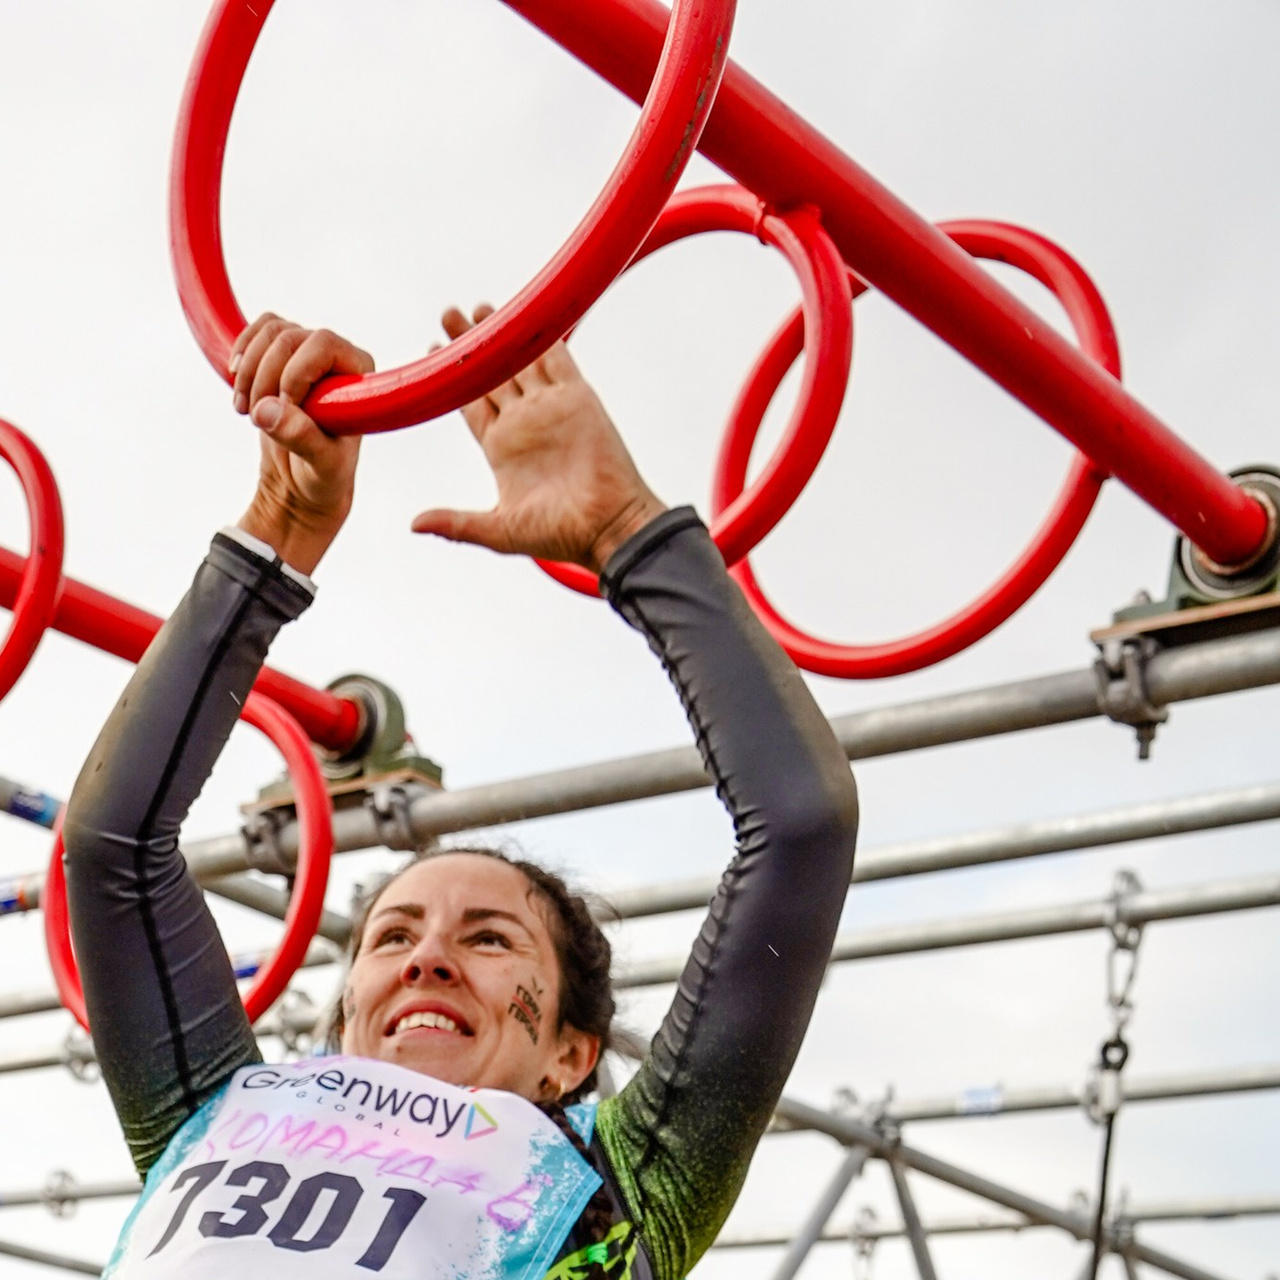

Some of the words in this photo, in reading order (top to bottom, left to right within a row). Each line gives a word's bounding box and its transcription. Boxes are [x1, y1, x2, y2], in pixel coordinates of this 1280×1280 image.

[242, 1069, 466, 1138] Greenway
[296, 1091, 401, 1137] GLOBAL
[145, 1159, 428, 1272] 7301
